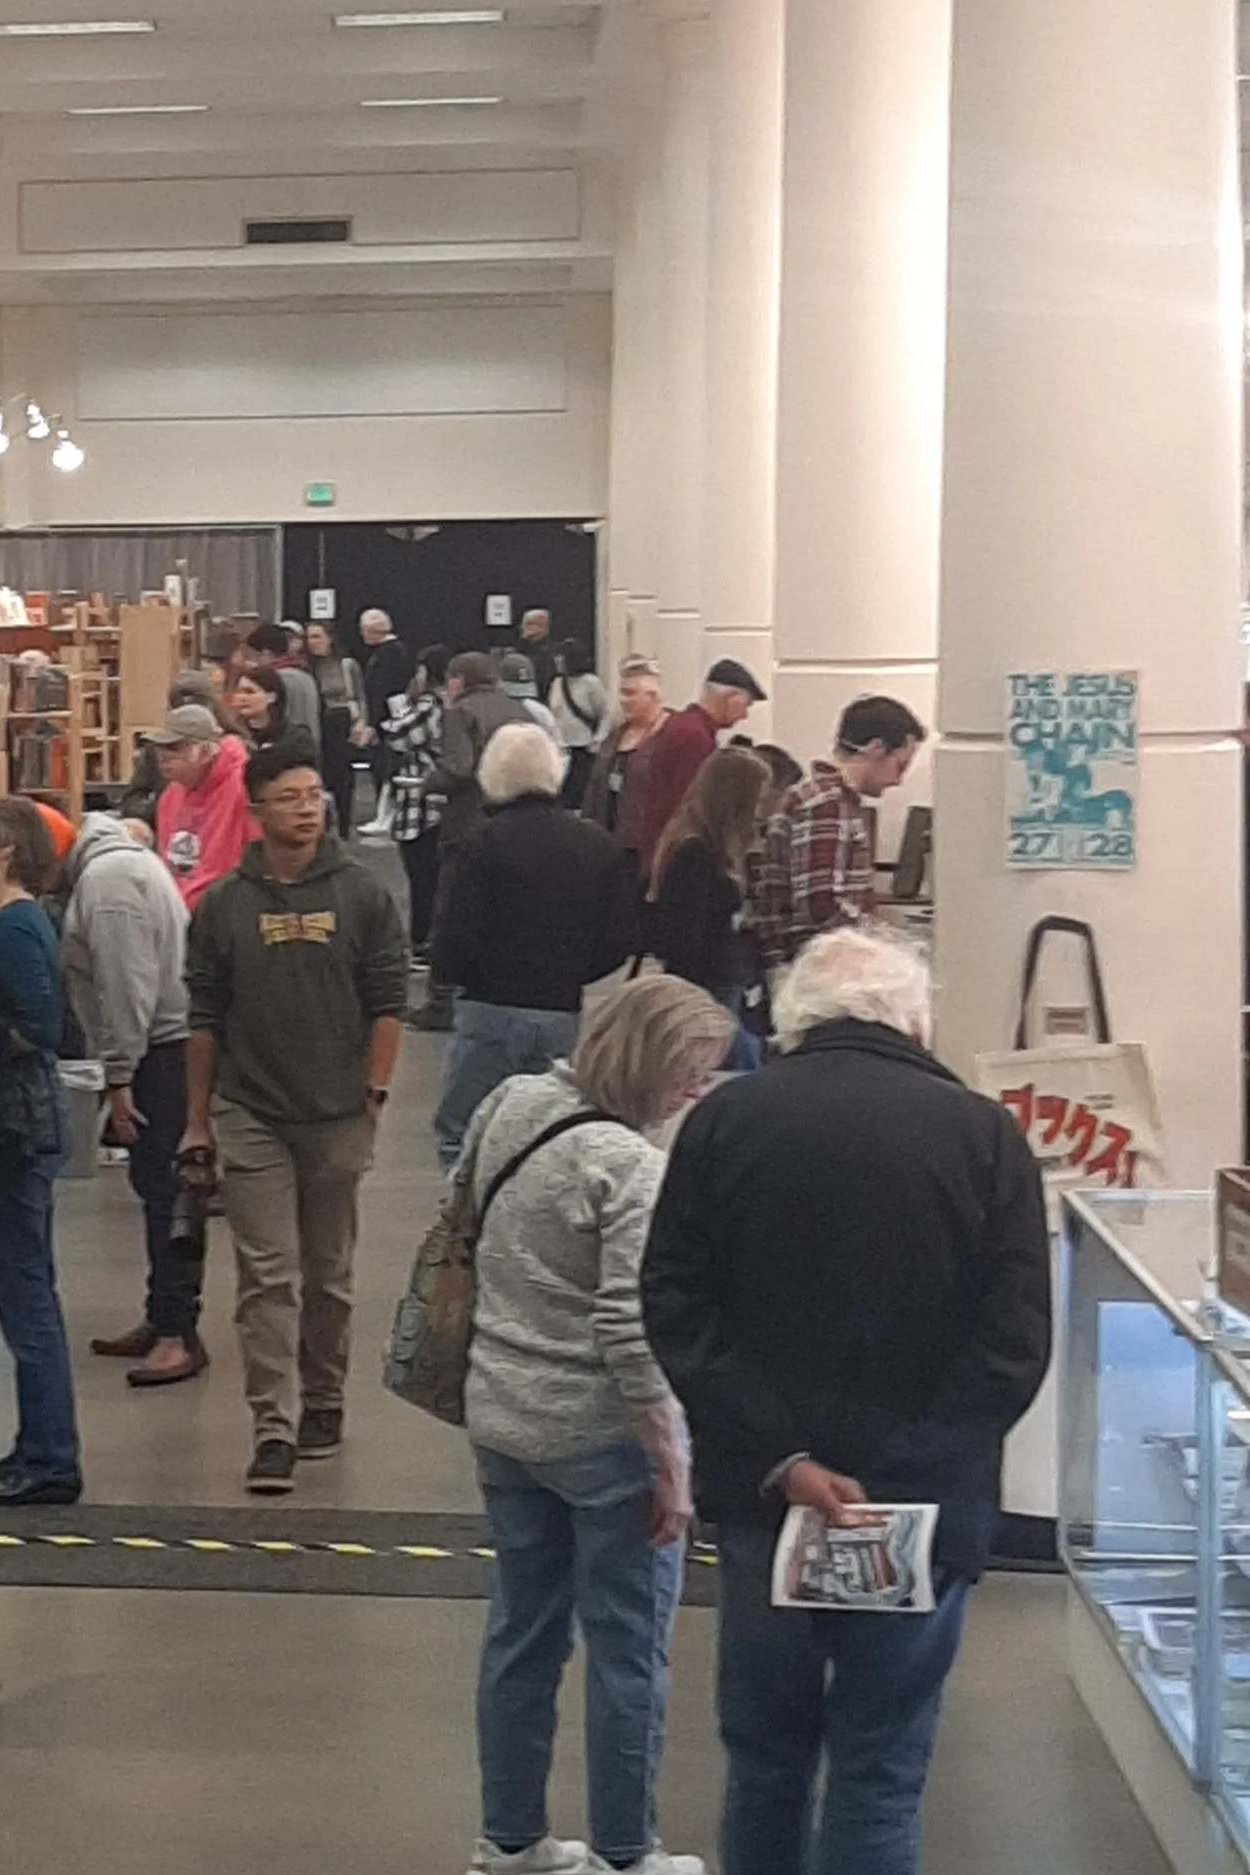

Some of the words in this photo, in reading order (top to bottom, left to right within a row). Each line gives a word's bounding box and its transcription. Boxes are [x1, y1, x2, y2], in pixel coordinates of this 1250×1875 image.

[1007, 674, 1055, 697] THE
[1009, 721, 1135, 749] CHAIN
[1007, 832, 1053, 856] 27
[1081, 832, 1134, 857] 28
